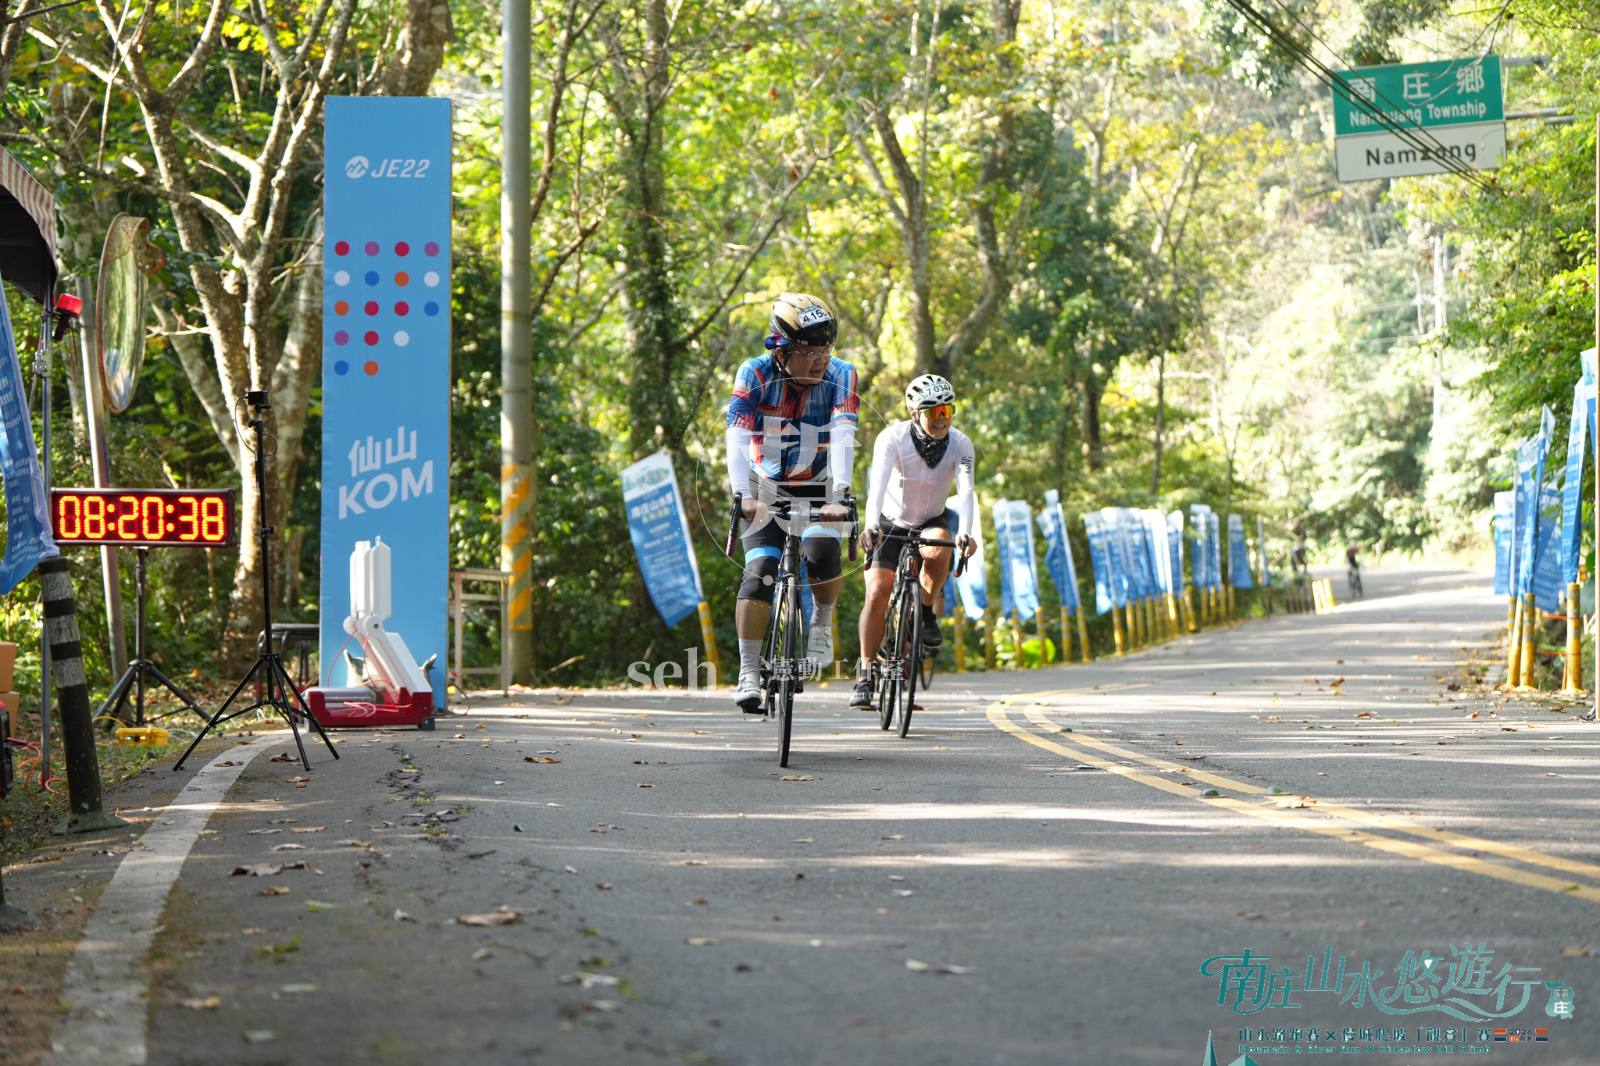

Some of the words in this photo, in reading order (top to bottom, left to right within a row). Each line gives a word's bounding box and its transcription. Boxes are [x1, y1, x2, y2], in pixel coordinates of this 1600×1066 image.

[1427, 102, 1486, 120] Township
[371, 159, 431, 178] JE22
[1366, 143, 1476, 166] Namzong
[347, 426, 417, 478] 仙山
[338, 459, 433, 521] KOM
[59, 495, 225, 541] 08:20:38
